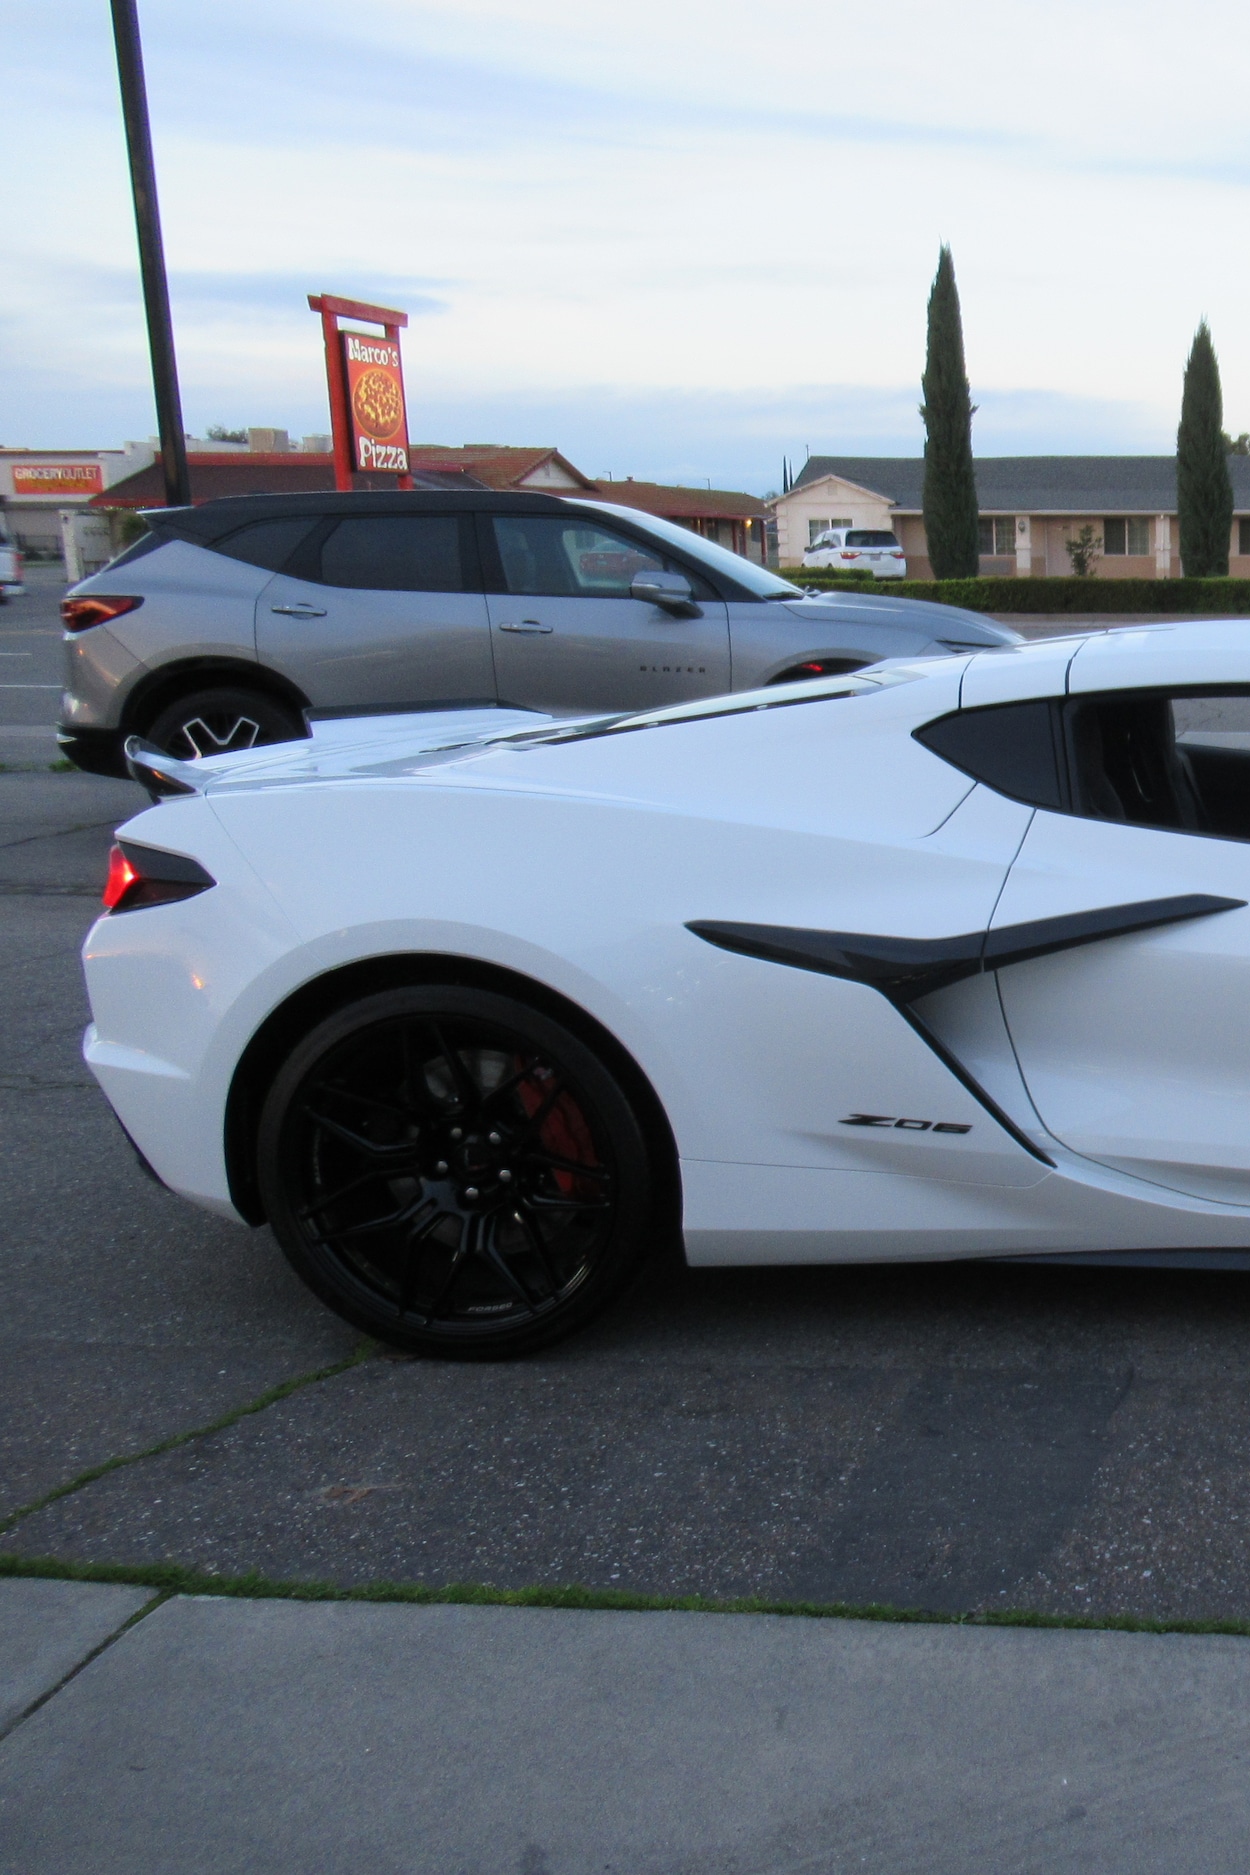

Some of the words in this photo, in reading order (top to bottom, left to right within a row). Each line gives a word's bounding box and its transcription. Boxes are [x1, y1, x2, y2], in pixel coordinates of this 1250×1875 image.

[347, 338, 399, 368] Marco's
[358, 436, 408, 471] Pizza
[14, 467, 62, 480] GROCERY
[62, 467, 97, 480] OUTLET
[639, 665, 706, 673] BLAZER
[838, 1113, 974, 1135] Z06
